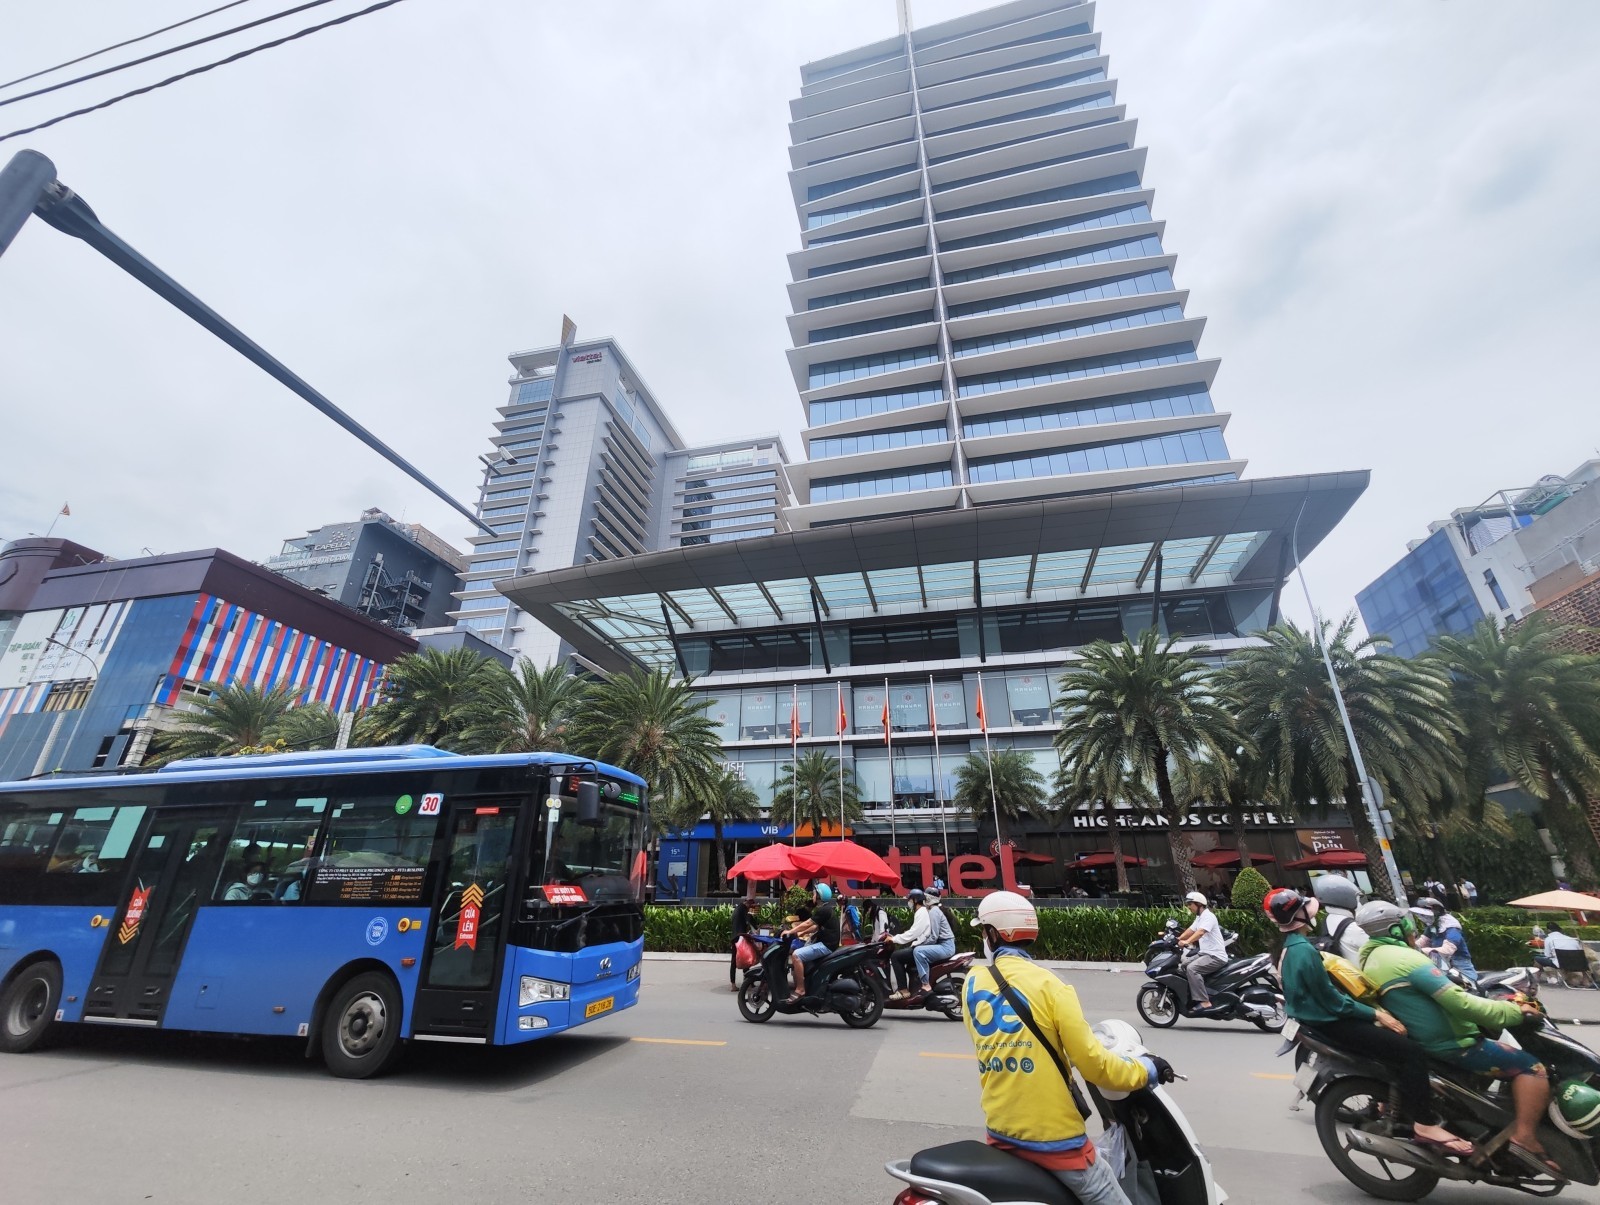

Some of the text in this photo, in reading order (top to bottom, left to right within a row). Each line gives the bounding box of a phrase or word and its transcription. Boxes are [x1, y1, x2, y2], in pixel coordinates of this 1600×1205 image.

[422, 796, 439, 812] 30
[761, 826, 778, 834] VIB
[464, 906, 476, 918] CỬA
[462, 920, 474, 932] LÊN
[967, 975, 1030, 1036] be
